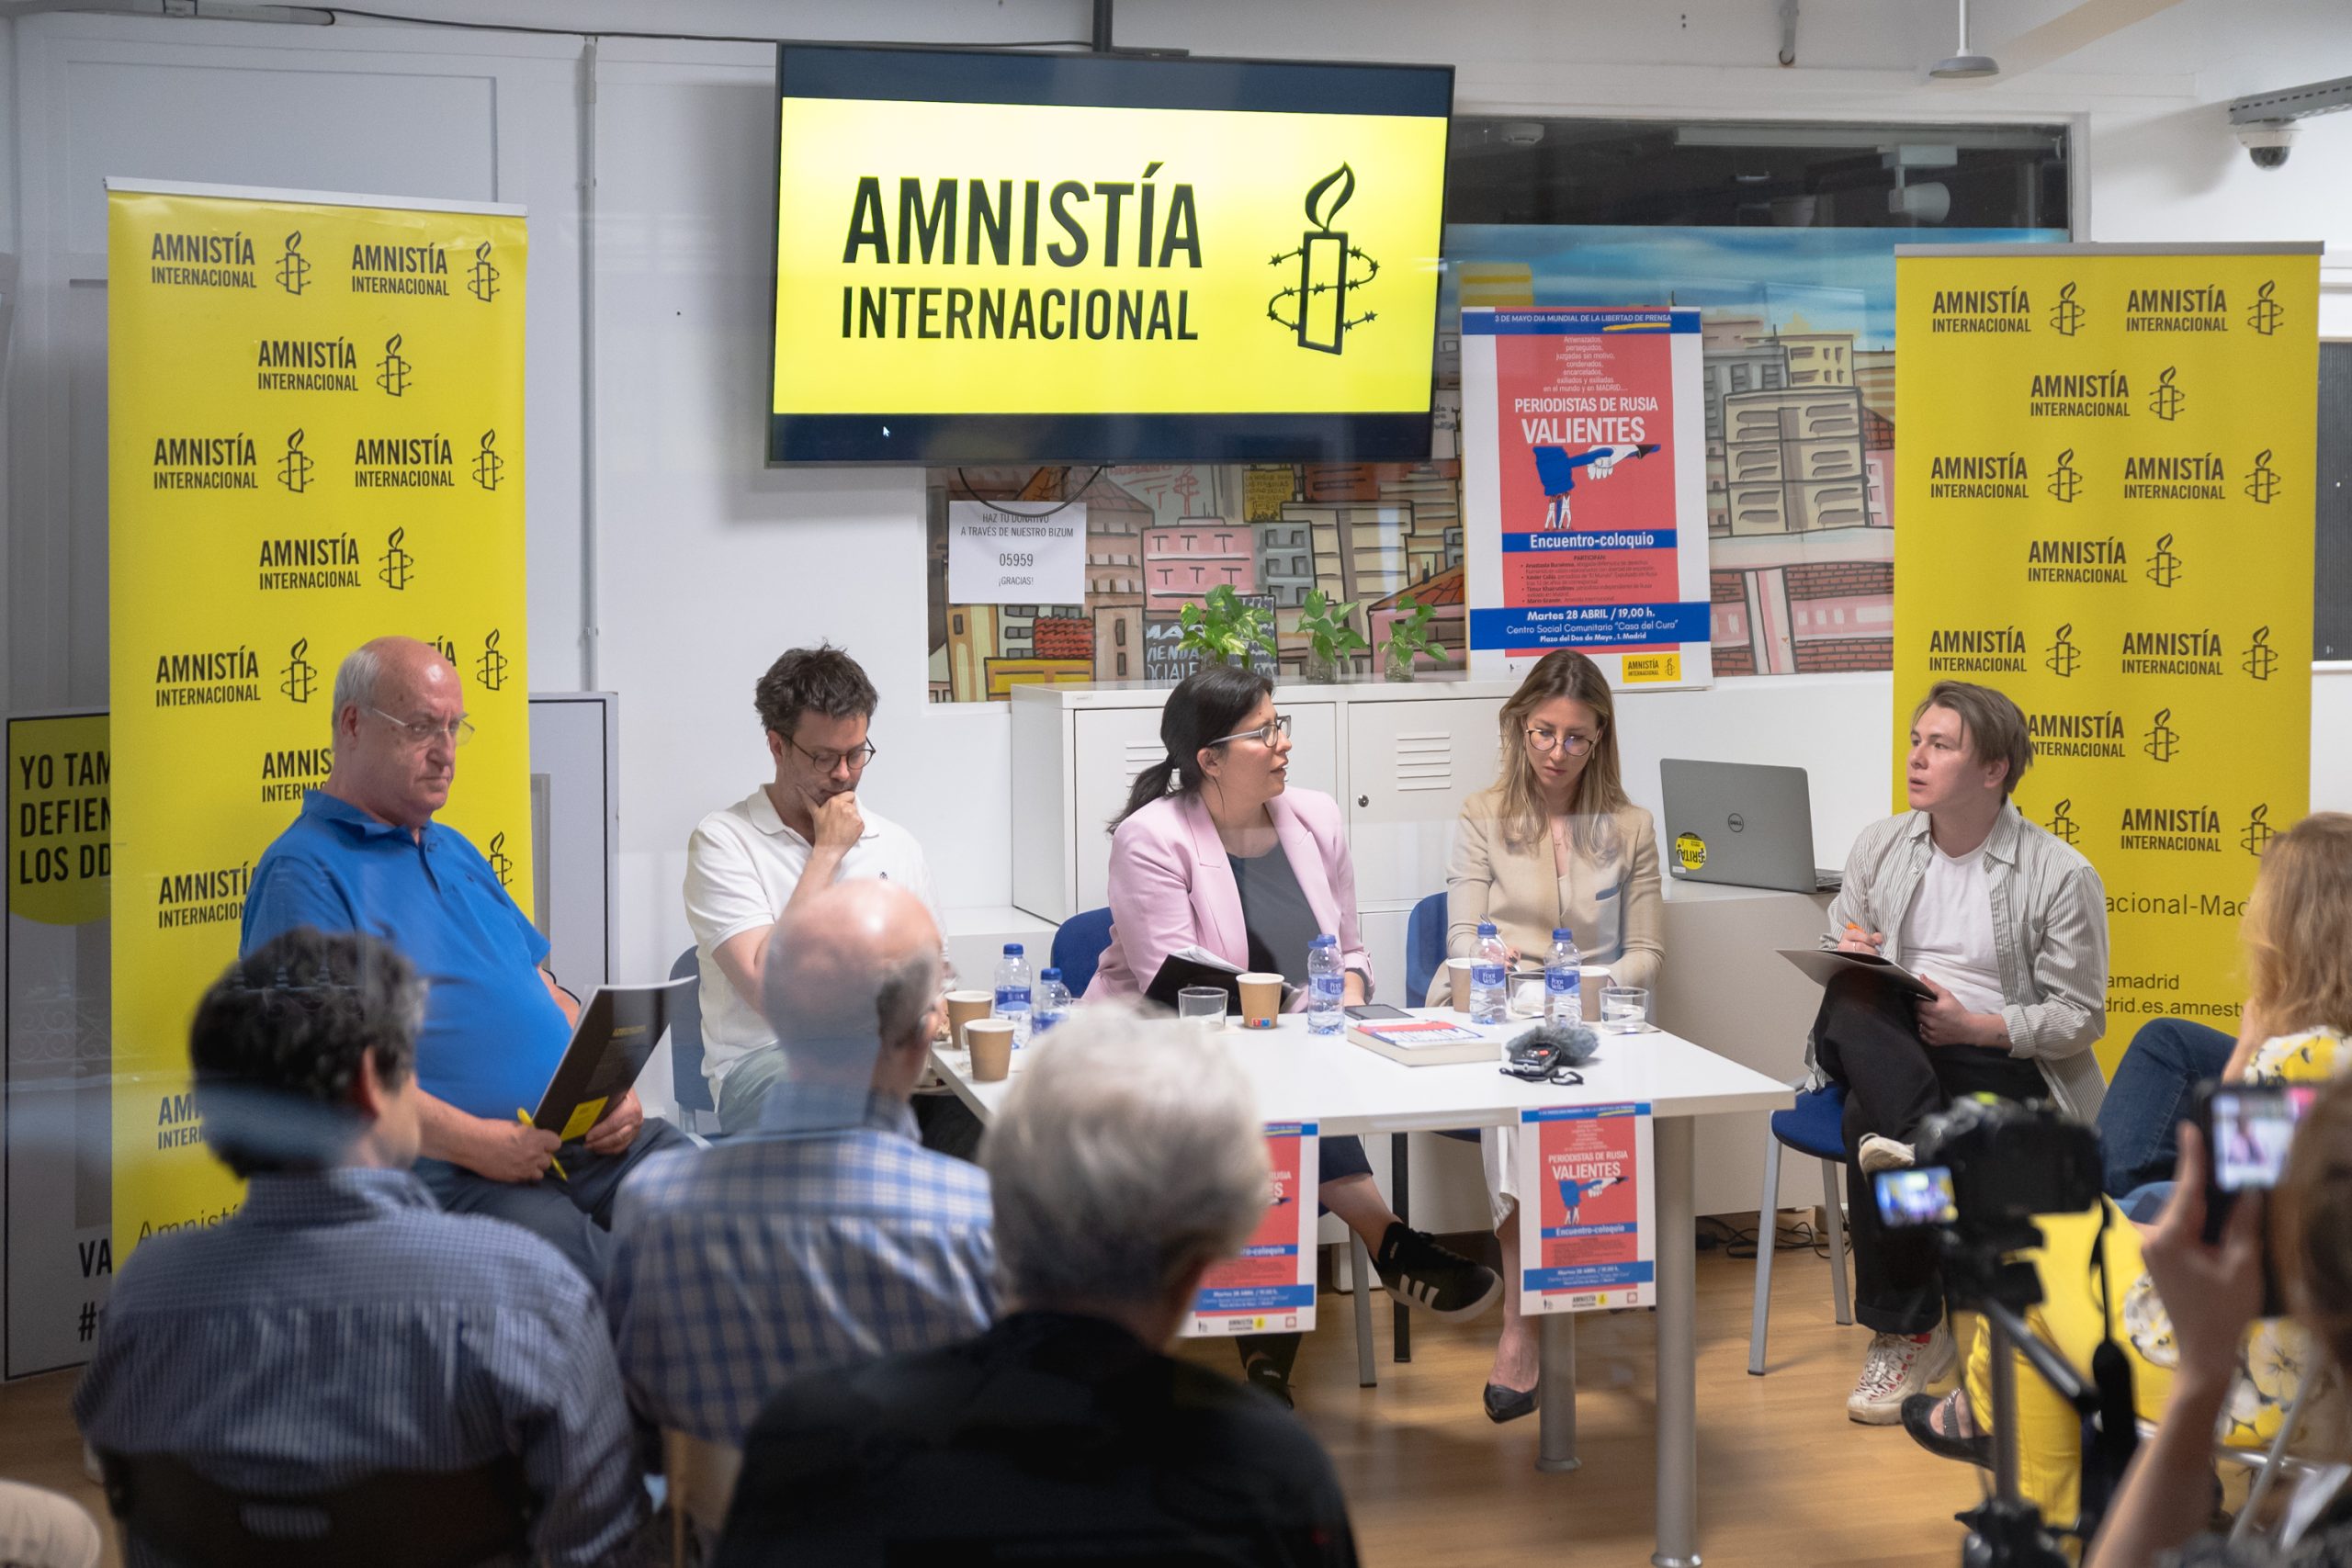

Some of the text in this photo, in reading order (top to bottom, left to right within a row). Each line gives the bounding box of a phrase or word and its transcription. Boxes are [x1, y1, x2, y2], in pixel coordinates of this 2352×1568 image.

[842, 162, 1204, 268] AMNISTÍA
[153, 231, 254, 265] AMNISTÍA
[352, 243, 447, 274] AMNISTÍA
[153, 266, 256, 288] INTERNACIONAL
[353, 276, 449, 296] INTERNACIONAL
[1933, 286, 2030, 313] AMNISTÍA
[2127, 285, 2226, 312] AMNISTÍA
[842, 286, 1199, 341] INTERNACIONAL
[1933, 319, 2031, 332] INTERNACIONAL
[2127, 318, 2228, 331] INTERNACIONAL
[258, 337, 356, 368] AMNISTÍA
[259, 373, 358, 390] INTERNACIONAL
[2031, 370, 2129, 398] AMNISTÍA
[1514, 396, 1658, 412] PERIODISTAS DE RUSIA
[2031, 402, 2130, 416] INTERNACIONAL
[1521, 416, 1645, 444] VALIENTES
[154, 433, 256, 465] AMNISTÍA
[356, 434, 452, 465] AMNISTÍA
[1931, 452, 2027, 479] AMNISTÍA
[2125, 453, 2223, 480] AMNISTÍA
[154, 472, 258, 489] INTERNACIONAL
[356, 471, 454, 487] INTERNACIONAL
[1931, 484, 2029, 498] INTERNACIONAL
[2125, 485, 2225, 499] INTERNACIONAL
[982, 513, 1049, 524] HAZ TU DONATIVO
[961, 525, 1074, 537] A TRAVÉS DE NUESTRO BIZUM
[260, 533, 358, 567] AMNISTÍA
[1530, 533, 1654, 549] Encuentro-coloquio
[2029, 536, 2126, 564] AMNISTÍA
[1000, 553, 1034, 567] 05959
[260, 571, 360, 590] INTERNACIONAL
[999, 576, 1034, 587] ¡GRACIAS!
[2029, 568, 2127, 582] INTERNACIONAL
[1527, 607, 1656, 621] Martes 28 ABRIL / 19,00 h.
[1507, 626, 1534, 634] Centro
[1537, 624, 1562, 633] Social
[1564, 623, 1612, 633] Comunitario
[1640, 620, 1654, 630] del
[1540, 635, 1557, 643] Plaza
[1571, 634, 1584, 642] Dos
[1594, 634, 1612, 643] Mayo
[1623, 632, 1646, 640] Madrid
[1930, 626, 2025, 653] AMNISTÍA
[2123, 629, 2222, 656] AMNISTÍA
[156, 646, 258, 683] AMNISTÍA
[1627, 658, 1659, 670] AMNISTÍA
[1930, 658, 2027, 671] INTERNACIONAL
[2122, 660, 2222, 675] INTERNACIONAL
[156, 684, 260, 706] INTERNACIONAL
[2029, 711, 2125, 739] AMNISTÍA
[2031, 741, 2126, 758] NTERNACIONAL
[19, 750, 110, 790] YO TAM
[20, 796, 110, 838] DEFIEN
[2121, 806, 2220, 832] AMNISTÍA
[2121, 836, 2221, 852] INTERNACIONAL
[20, 846, 69, 885] LOS
[1548, 1150, 1628, 1163] PERIODISTAS DE RUSIA
[1551, 1162, 1621, 1179] VALIENTES
[1556, 1224, 1624, 1236] Encuentro-coloquio
